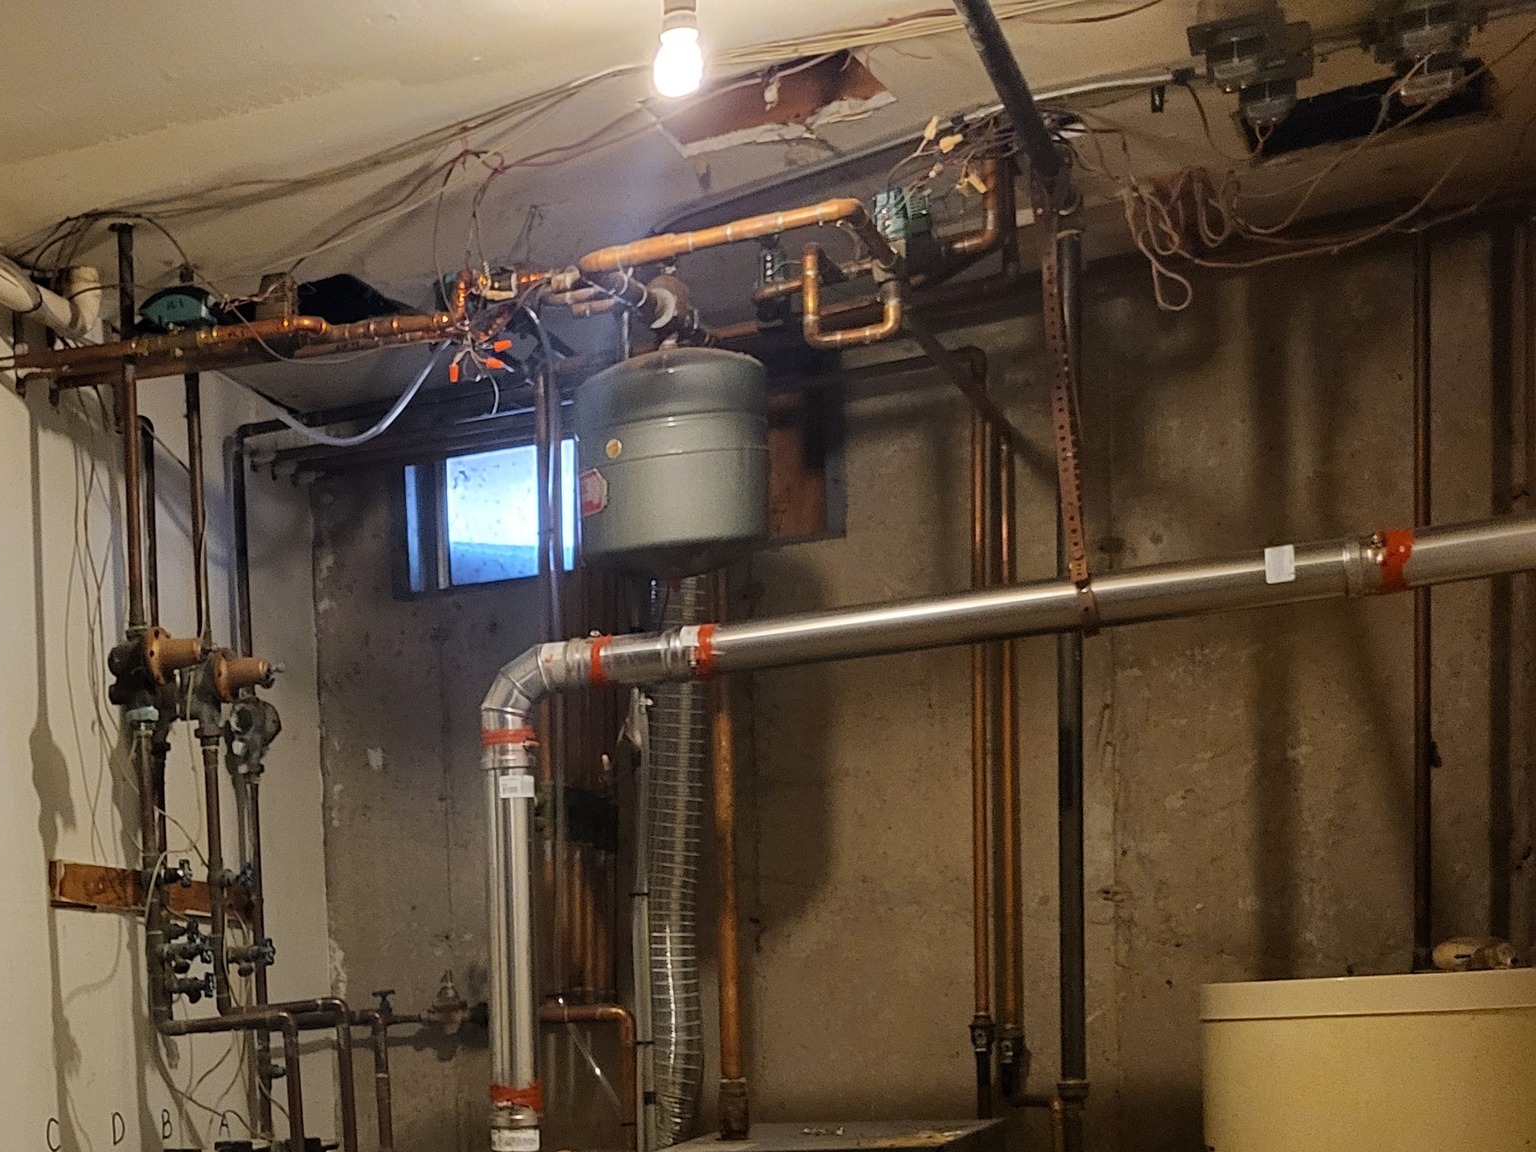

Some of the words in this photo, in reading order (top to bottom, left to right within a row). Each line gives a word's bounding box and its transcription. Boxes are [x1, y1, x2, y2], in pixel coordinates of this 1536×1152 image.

[46, 1117, 62, 1152] C
[111, 1111, 125, 1146] D
[161, 1108, 173, 1139] B
